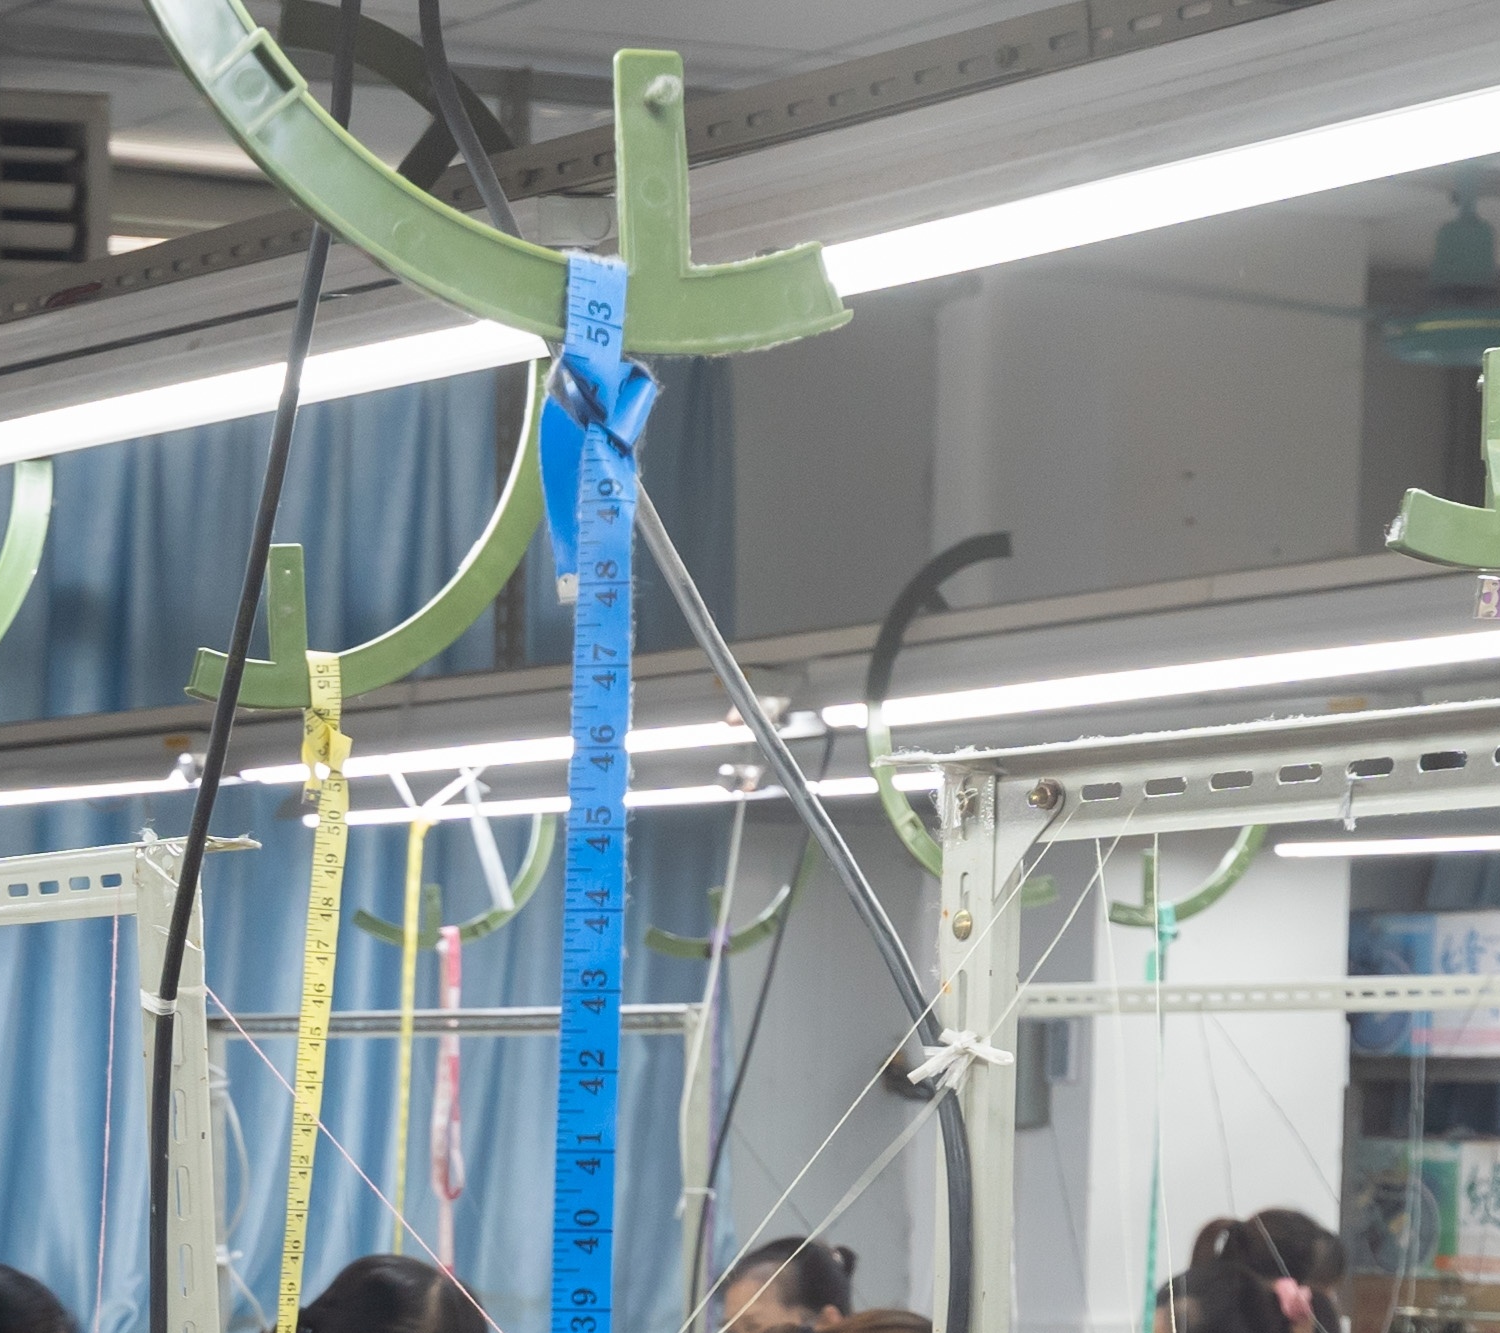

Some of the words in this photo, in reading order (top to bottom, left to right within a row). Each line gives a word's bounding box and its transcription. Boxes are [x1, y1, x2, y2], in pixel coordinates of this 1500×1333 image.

[586, 299, 612, 347] 53
[597, 477, 624, 526] 49
[595, 559, 619, 608] 48
[592, 643, 617, 689] 47
[590, 724, 616, 773] 46
[326, 810, 341, 837] 50
[585, 805, 612, 854] 45
[324, 853, 341, 881] 49
[321, 897, 334, 922] 48
[584, 888, 611, 935] 44
[317, 940, 331, 966] 47
[312, 983, 326, 1008] 46
[581, 967, 608, 1014] 43
[309, 1026, 322, 1052] 45
[307, 1069, 318, 1094] 44
[579, 1048, 605, 1095] 42
[301, 1112, 315, 1136] 43
[299, 1155, 310, 1178] 42
[577, 1131, 603, 1177] 41
[295, 1200, 305, 1222] 41
[573, 1208, 600, 1255] 40
[291, 1240, 301, 1264] 40
